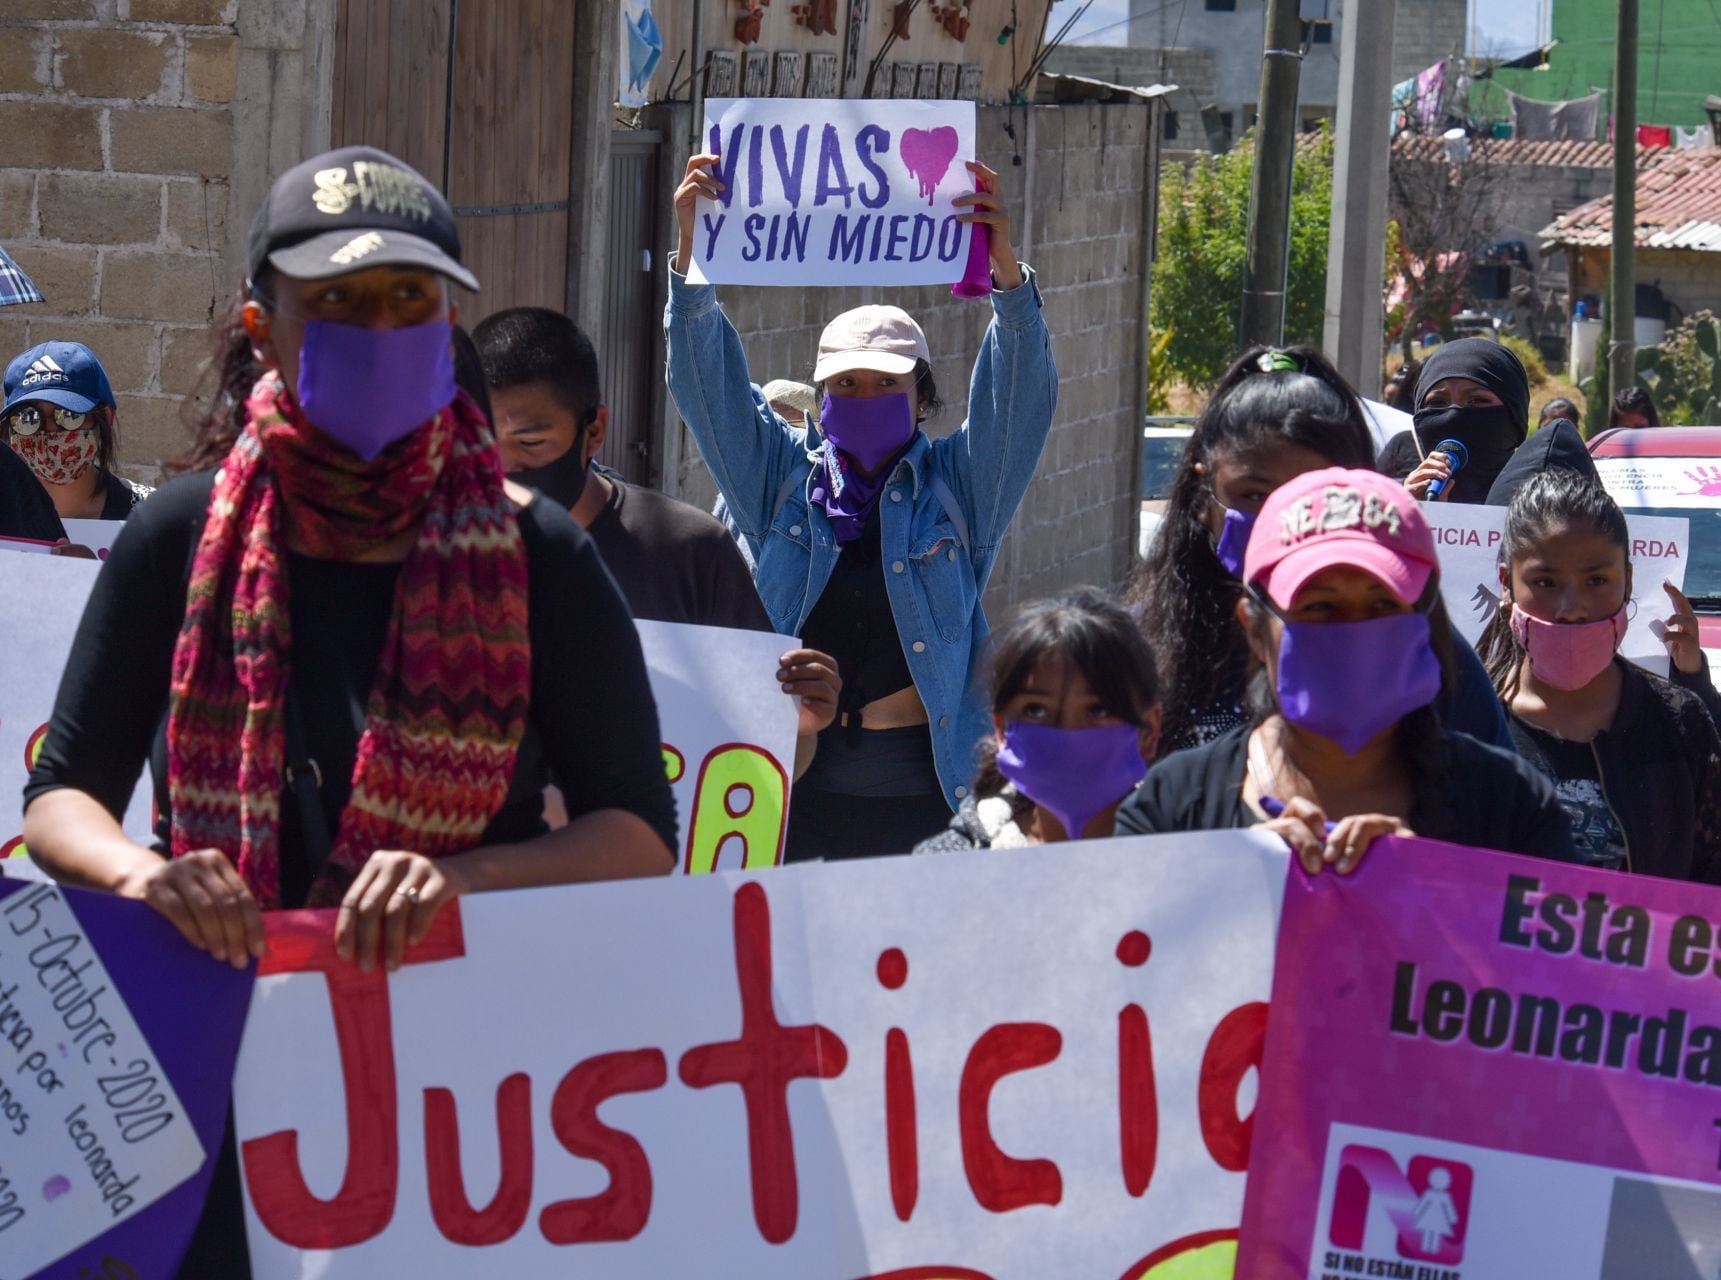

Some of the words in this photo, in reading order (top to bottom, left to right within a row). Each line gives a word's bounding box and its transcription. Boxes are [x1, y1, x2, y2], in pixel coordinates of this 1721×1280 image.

[709, 122, 891, 210] VIVAS
[703, 213, 726, 262] Y
[741, 211, 812, 263] SIN
[827, 212, 963, 264] MIEDO
[22, 371, 69, 386] adidas
[1499, 873, 1652, 970] Esta
[1667, 914, 1721, 980] e
[1389, 960, 1721, 1087] Leonarda
[16, 1050, 65, 1094] por
[237, 880, 1274, 1250] Justicia
[1323, 1251, 1341, 1269] SI
[1343, 1255, 1364, 1273] NO
